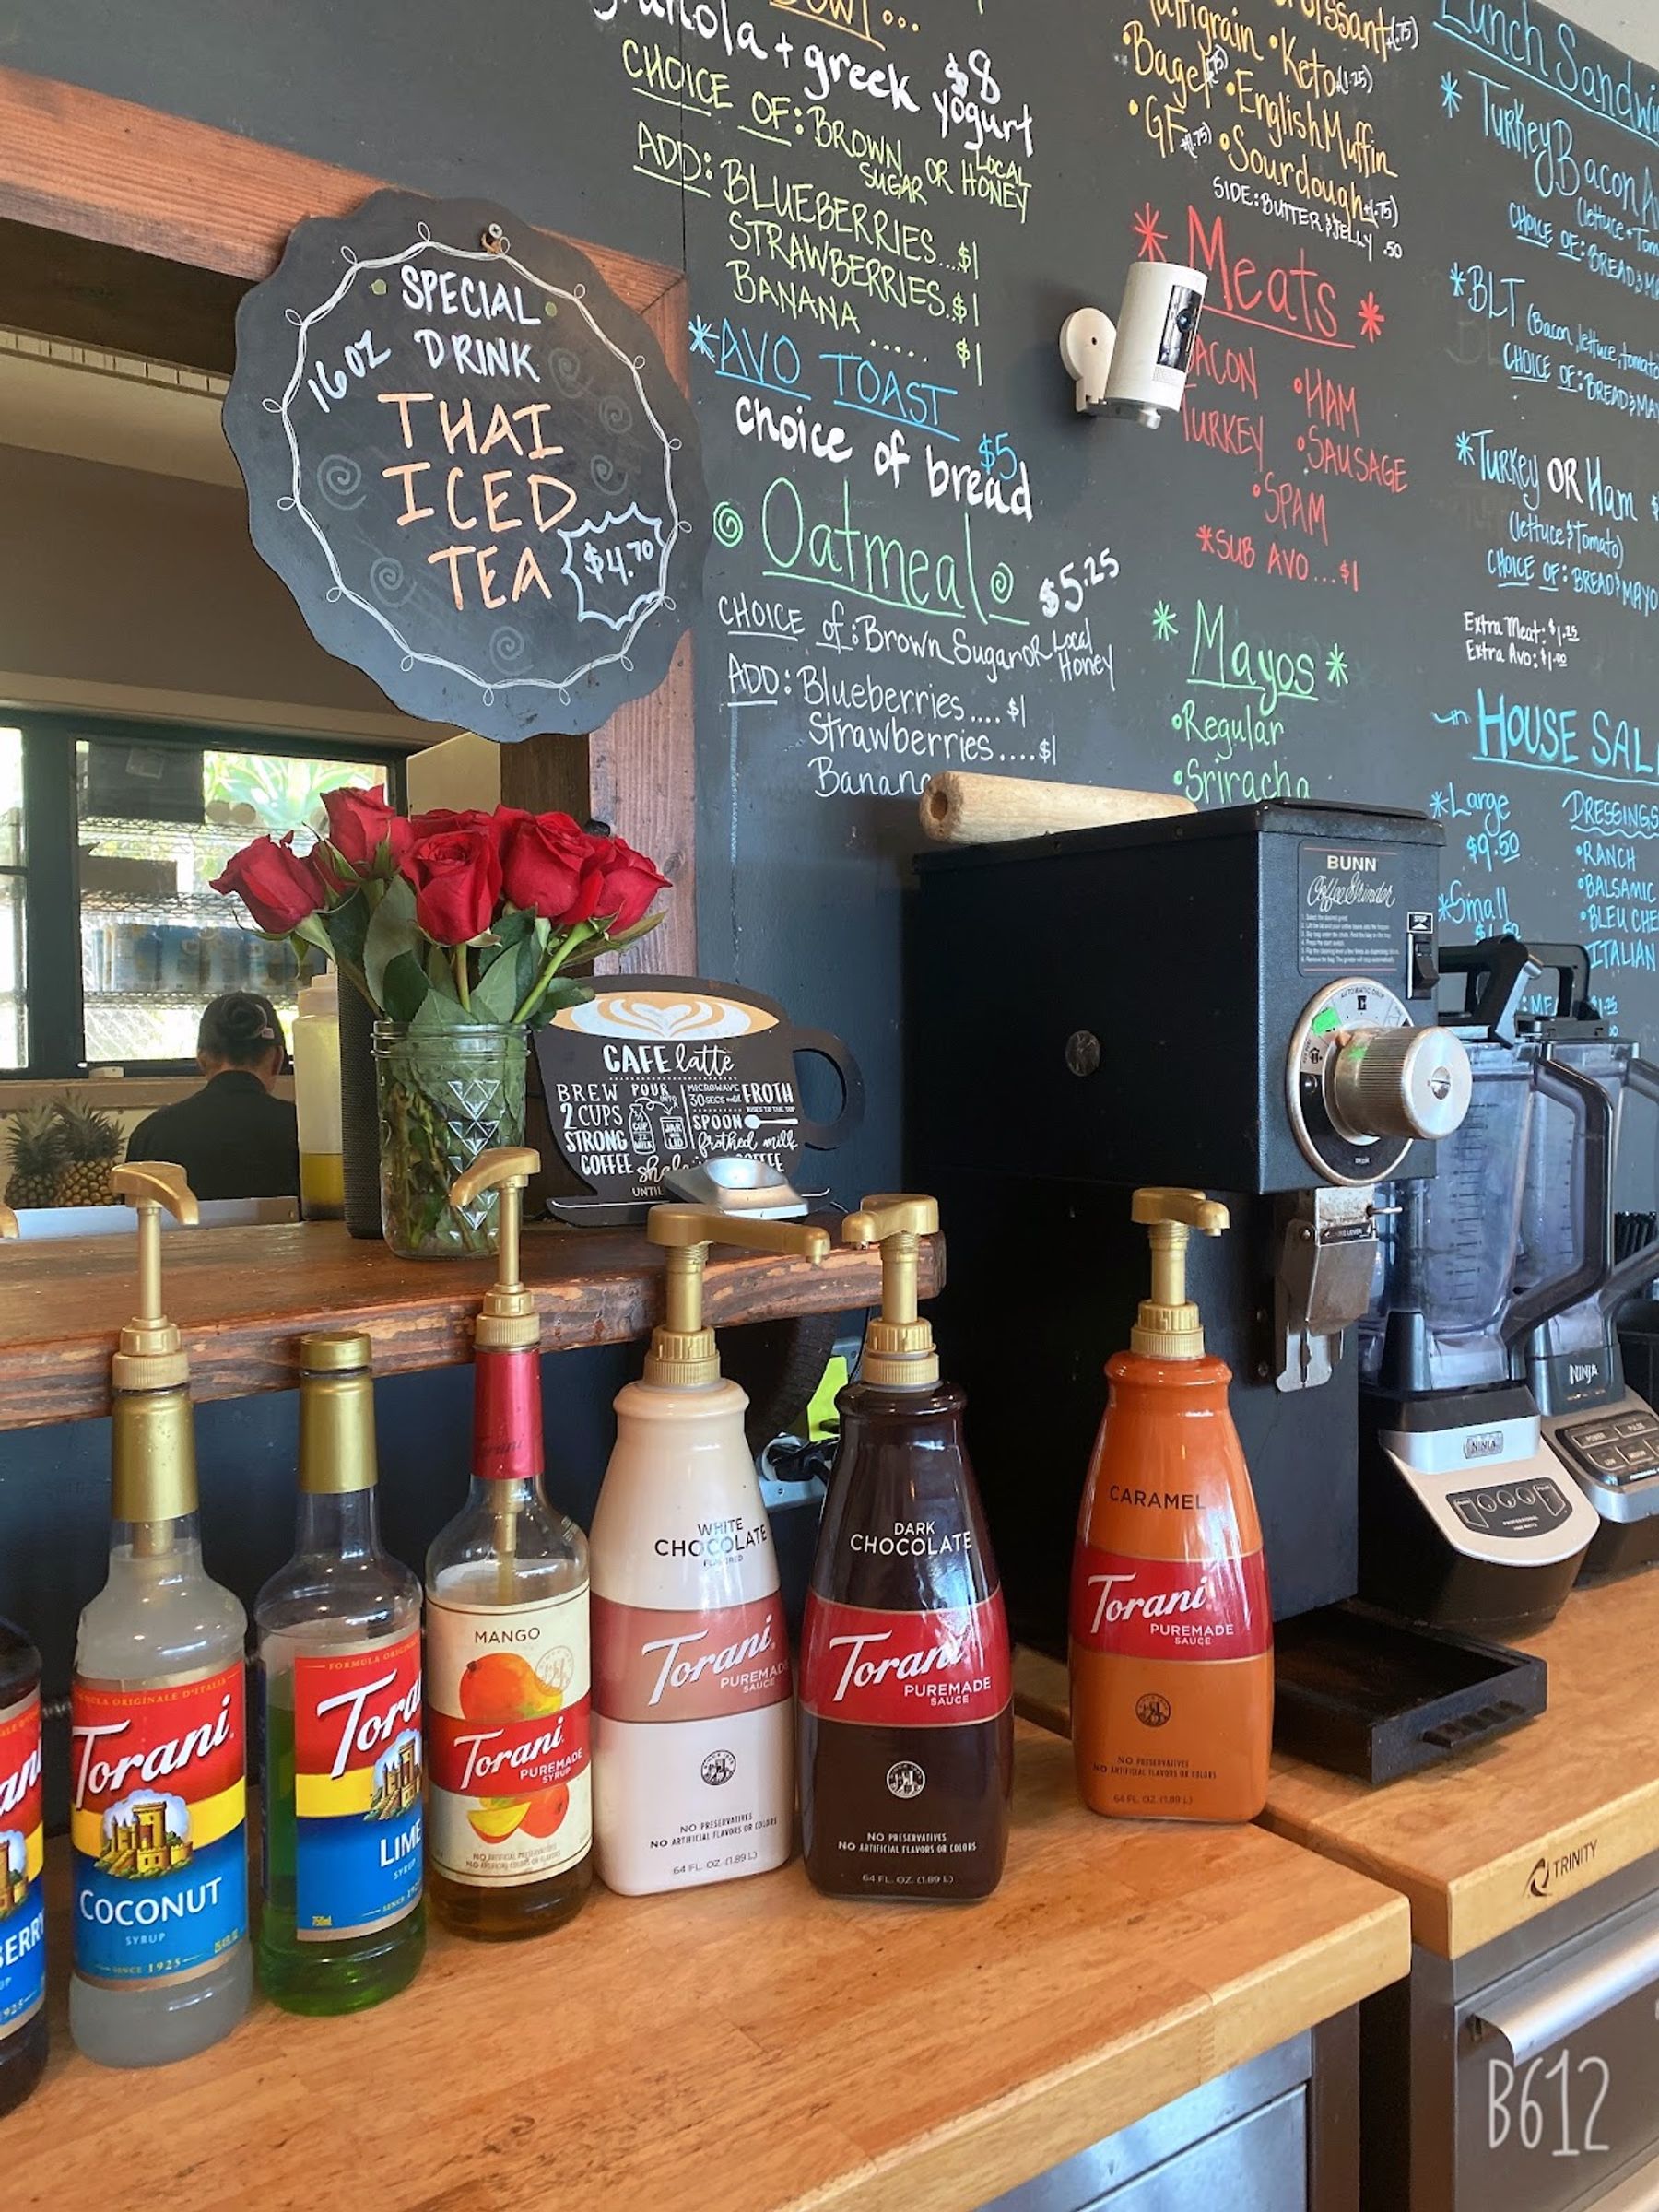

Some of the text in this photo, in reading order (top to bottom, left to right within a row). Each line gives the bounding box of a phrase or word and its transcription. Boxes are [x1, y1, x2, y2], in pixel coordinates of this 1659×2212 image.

[804, 34, 920, 112] greek
[944, 48, 1002, 105] $8
[1122, 20, 1211, 109] Bagel
[1279, 27, 1336, 99] Keto
[621, 38, 735, 110] CHOICE
[807, 105, 904, 171] BROWN
[924, 158, 954, 194] OR
[973, 149, 1033, 188] LOCAL
[1145, 95, 1189, 158] GF
[1236, 68, 1399, 179] English Muffin
[859, 159, 1029, 224] SUGAR HONEY
[1227, 124, 1379, 230] Sourdough
[1261, 192, 1323, 232] BUTTER
[1509, 201, 1554, 244] CHOICE
[1587, 243, 1636, 288] BREAD
[400, 264, 542, 324] SPECIAL
[1188, 205, 1338, 338] Meats
[725, 259, 862, 334] BANANA
[1466, 264, 1526, 329] BLT
[414, 328, 541, 383] DRINK
[1503, 342, 1551, 380] CHOICE
[1583, 372, 1629, 410] BREAD
[819, 354, 959, 426] TOAST
[1188, 334, 1359, 439] ACON HAM
[378, 392, 565, 461] THAI
[735, 394, 1034, 523] choice of bread
[978, 432, 1019, 480] $5
[1307, 425, 1409, 494] SAUSAGE
[382, 462, 579, 533] ICED
[1265, 471, 1329, 547] SPAM
[1547, 457, 1584, 504] OR
[1585, 456, 1639, 522] Ham
[761, 477, 989, 626] Oatmeal
[1215, 528, 1256, 569] SUB
[428, 546, 553, 612] TEA
[1038, 547, 1121, 618] $5.25
[1487, 548, 1535, 582] CHOICE
[1571, 566, 1615, 597] BREAD
[719, 595, 1094, 684] CHOICE Brown Sugar Local
[1464, 611, 1504, 637] Extra
[1058, 642, 1116, 691] Honey
[1191, 599, 1316, 717] Mayos
[1465, 639, 1505, 663] Extra
[1182, 700, 1285, 760] Regular
[1477, 688, 1580, 763] HOUSE
[1185, 758, 1311, 805] Sriracha
[1449, 782, 1512, 838] Large
[1326, 855, 1377, 872] BUNN
[1582, 840, 1637, 873] RANCH
[1449, 879, 1510, 924] Small
[1585, 876, 1657, 905] BALSAMIC
[1587, 904, 1629, 933] BLEU
[1584, 938, 1656, 972] ITALIAN
[603, 1042, 735, 1077] CAFE latte
[556, 1083, 618, 1102] BREW
[631, 1083, 668, 1098] POUR
[687, 1083, 741, 1093] MICROWAVE
[688, 1093, 706, 1107] 30
[741, 1082, 795, 1105] FROTH
[559, 1102, 578, 1130] 2
[578, 1104, 624, 1127] CUPS
[692, 1114, 743, 1131] SPOON
[564, 1129, 629, 1154] STRONG
[581, 1153, 635, 1176] COFFEE
[698, 1129, 799, 1159] frothed milk
[1569, 1363, 1599, 1385] NINJA
[1109, 1485, 1206, 1511] CARAMEL
[653, 1524, 768, 1559] CHOCOLATE
[698, 1517, 744, 1537] WHITE
[849, 1530, 973, 1557] CHOCOLATE
[894, 1521, 935, 1536] DARK
[1088, 1571, 1208, 1635] Torani
[474, 1627, 542, 1645] MANGO
[1150, 1622, 1235, 1638] PUREMADE
[1174, 1636, 1212, 1647] SAUCE
[641, 1614, 773, 1708] Torani
[743, 1677, 776, 1694] SAUCE
[903, 1676, 993, 1698] PUREMADE
[929, 1694, 971, 1706] SAUCE
[72, 1694, 231, 1810] Torani
[453, 1716, 565, 1791] Torani
[520, 1747, 584, 1781] PUREMADE
[542, 1767, 571, 1784] SYRUP
[380, 1818, 422, 1867] LIME
[649, 1839, 668, 1849] NO
[679, 1823, 698, 1834] NO
[838, 1841, 857, 1852] NO
[866, 1830, 886, 1842] NO
[1553, 1839, 1599, 1879] TRINITY
[79, 1877, 222, 1927] COCONUT
[125, 1932, 166, 1947] SYRUP
[147, 1957, 182, 1973] 1925
